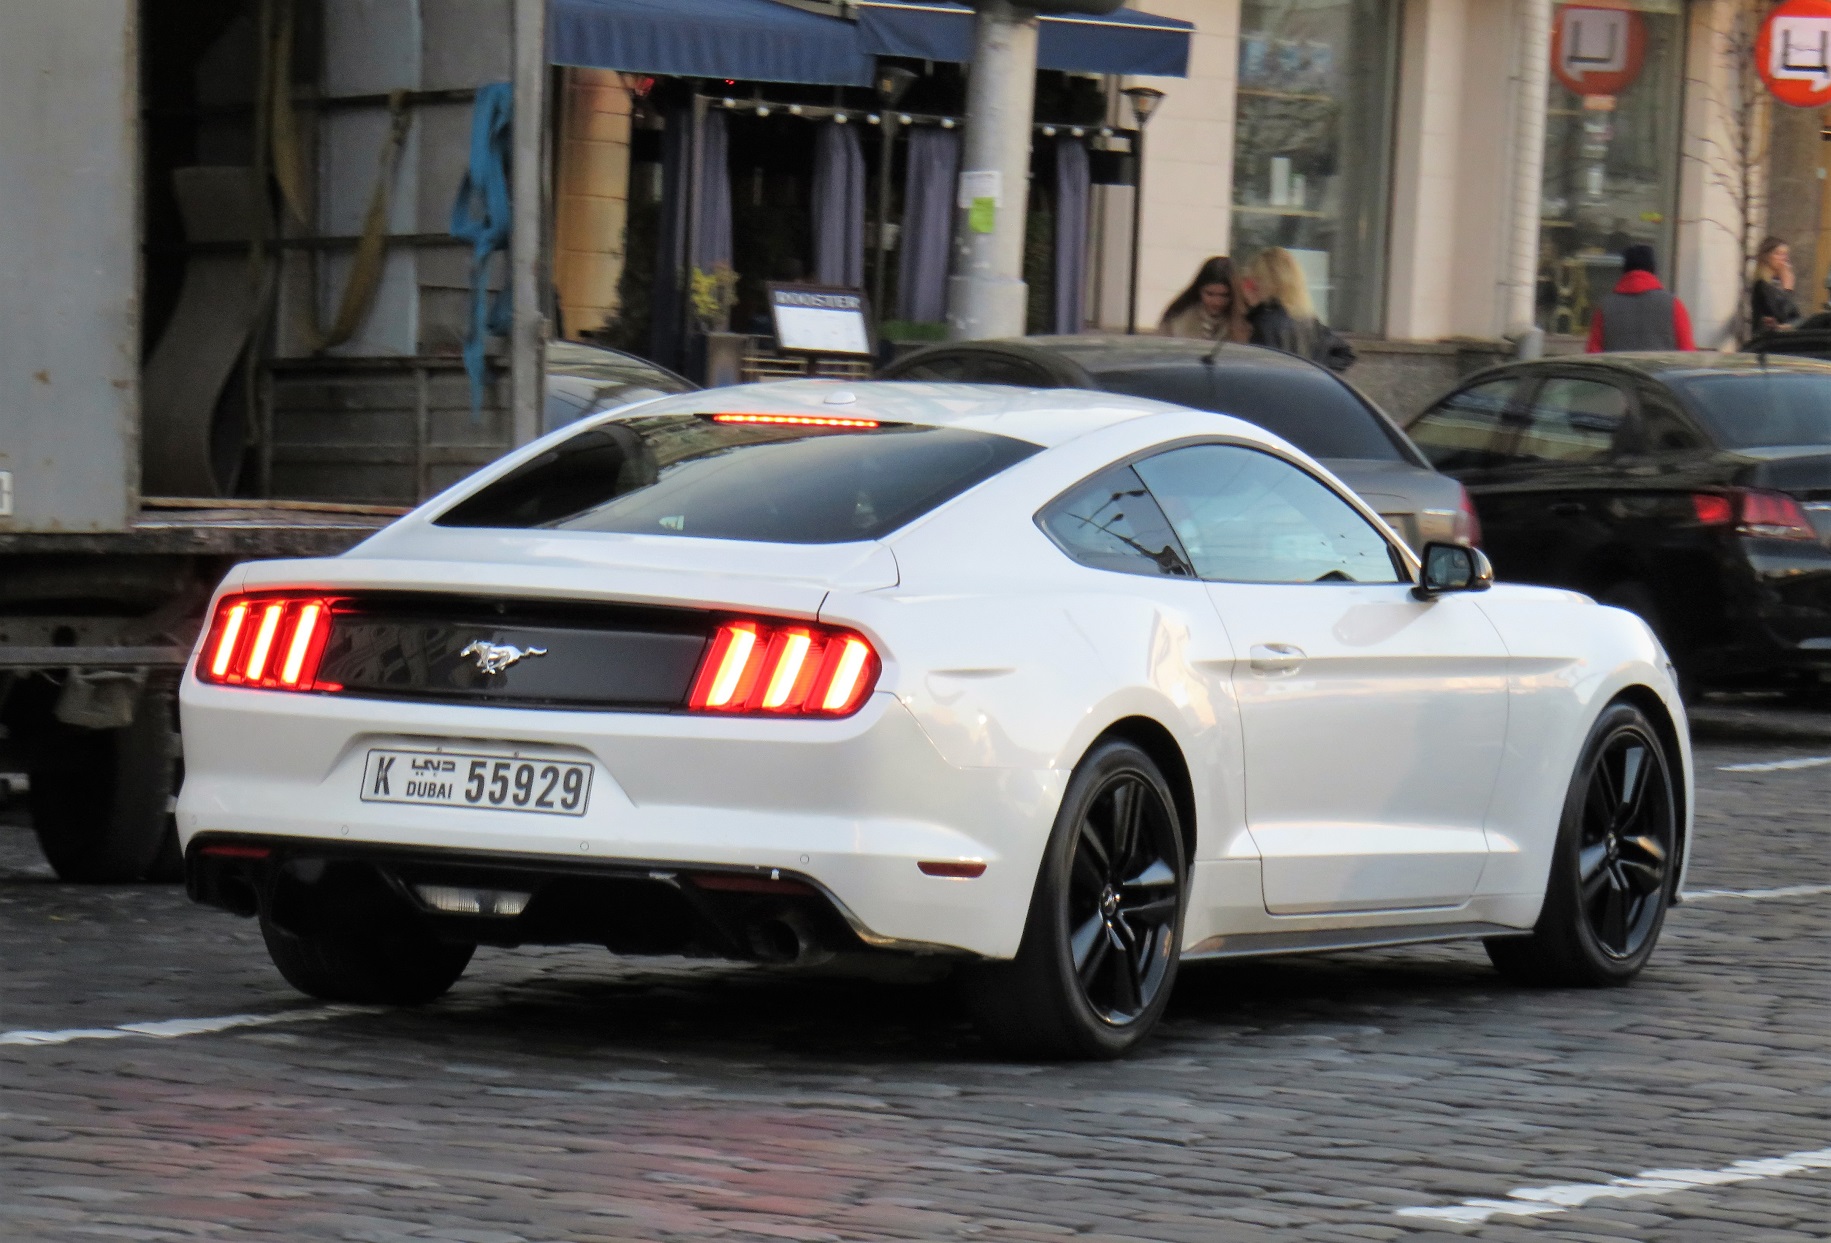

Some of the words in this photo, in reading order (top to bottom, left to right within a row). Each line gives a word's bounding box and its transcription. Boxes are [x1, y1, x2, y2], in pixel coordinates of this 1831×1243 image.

[411, 758, 456, 777] دبي
[374, 756, 396, 796] K
[464, 760, 584, 811] 55929
[406, 780, 453, 800] DUBAI
